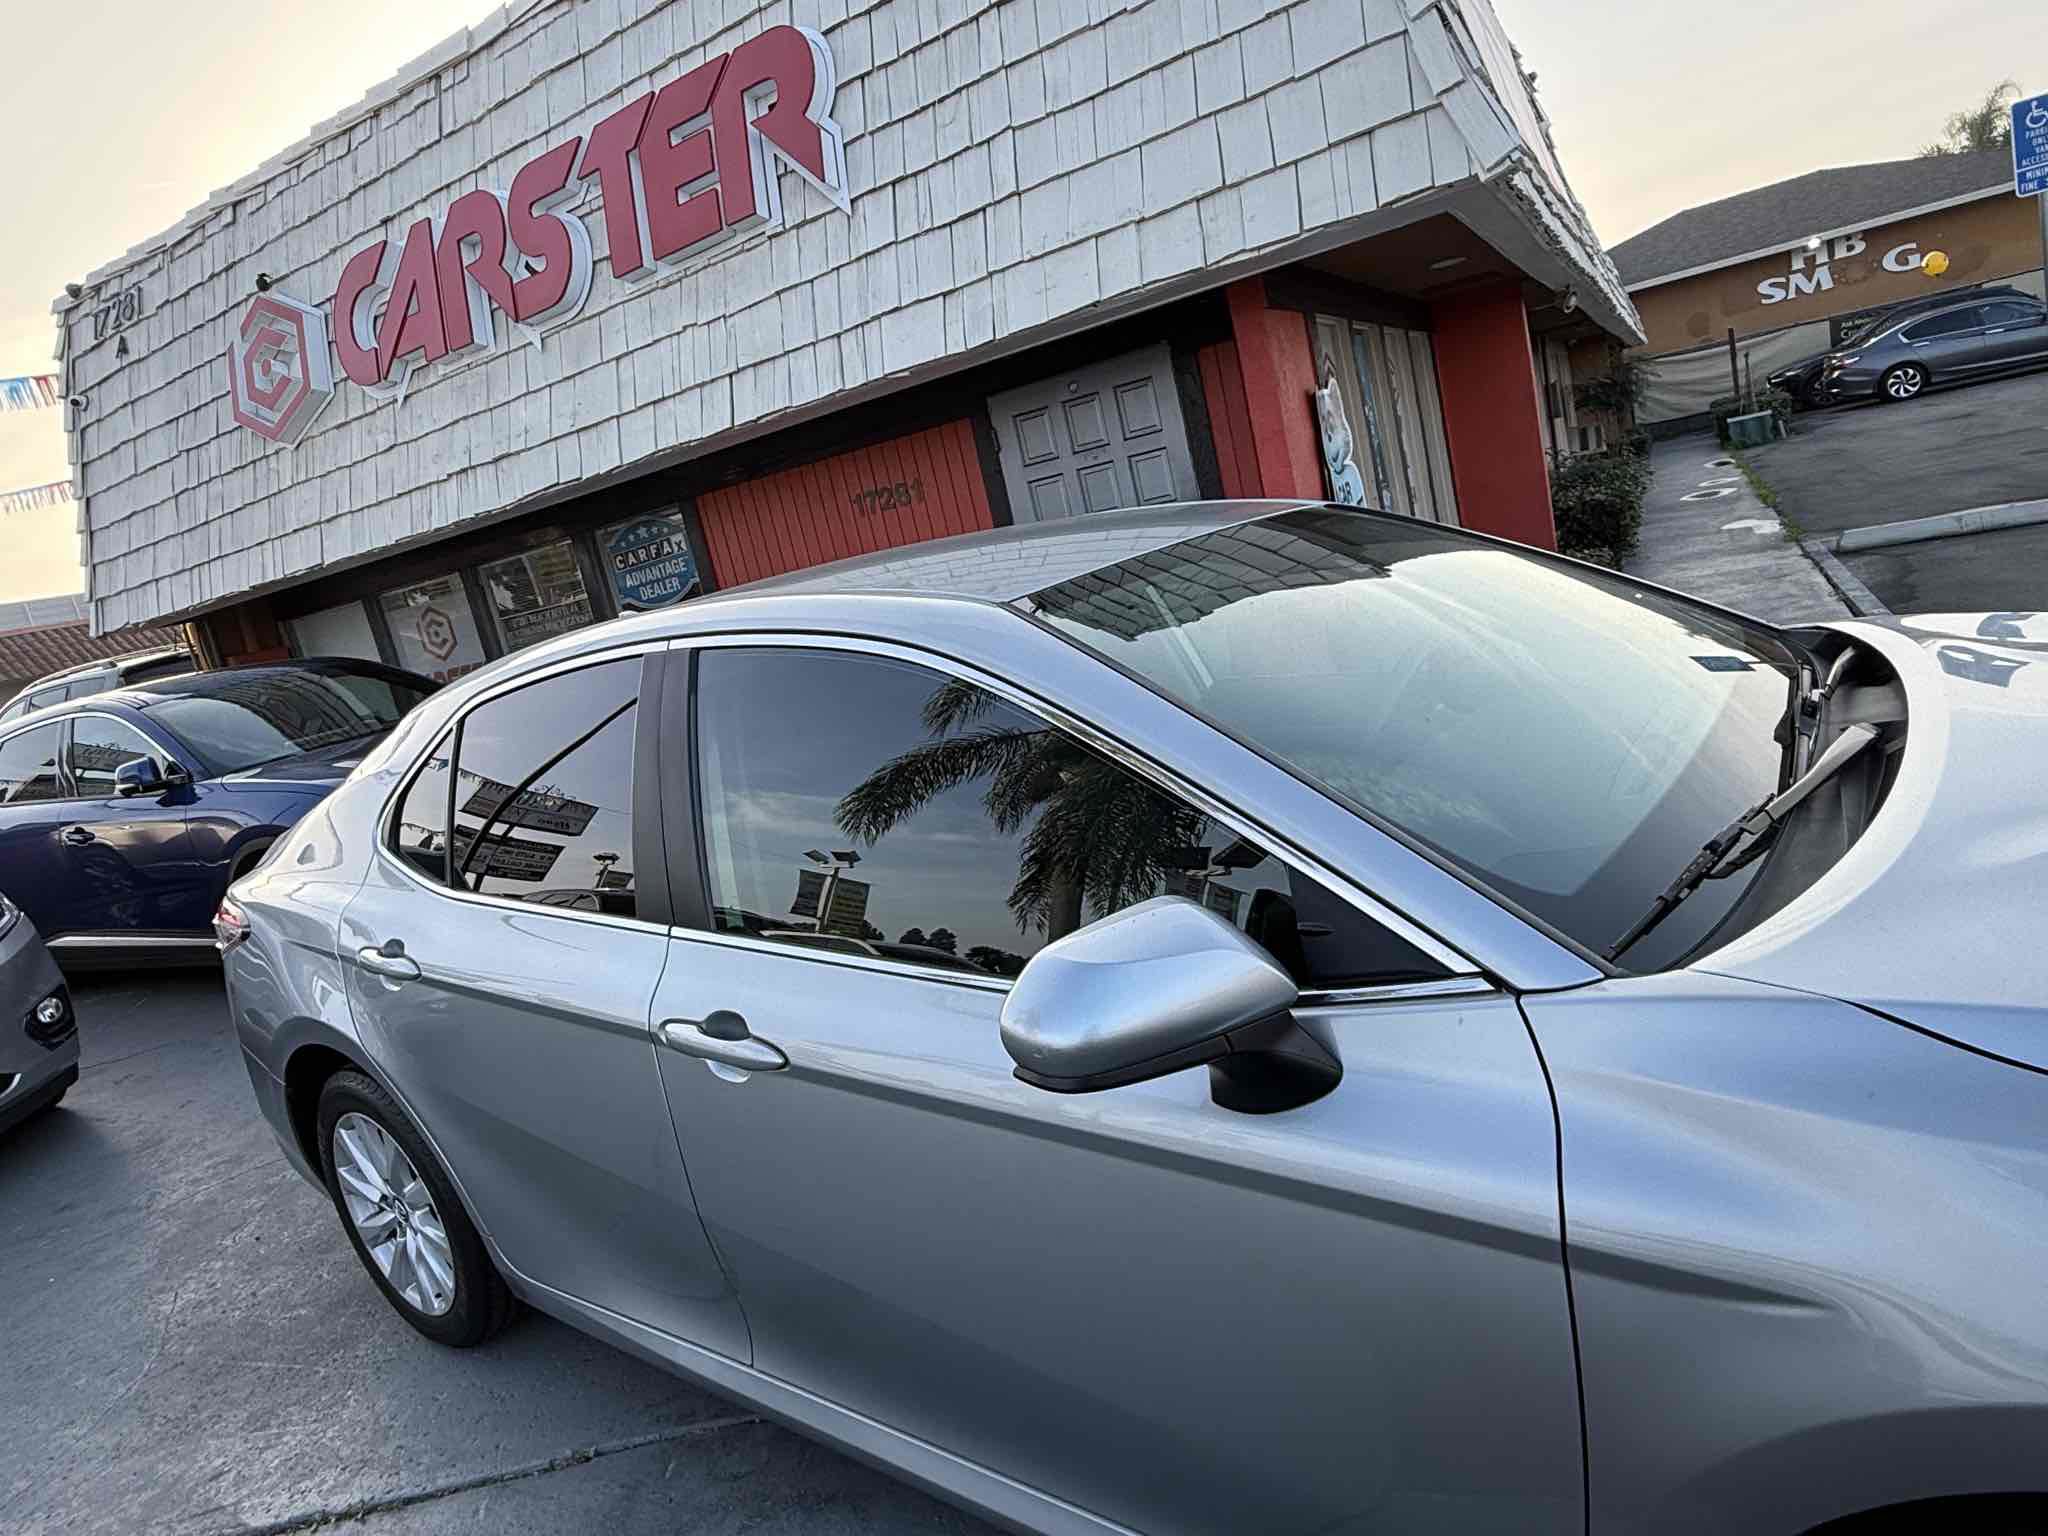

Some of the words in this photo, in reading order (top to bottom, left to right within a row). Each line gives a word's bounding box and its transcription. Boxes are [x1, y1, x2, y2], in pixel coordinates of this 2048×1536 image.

[333, 24, 842, 392] CARSTER
[615, 538, 688, 570] CARFAX
[625, 556, 688, 588] ADVANTAGE
[640, 576, 681, 601] DEALER
